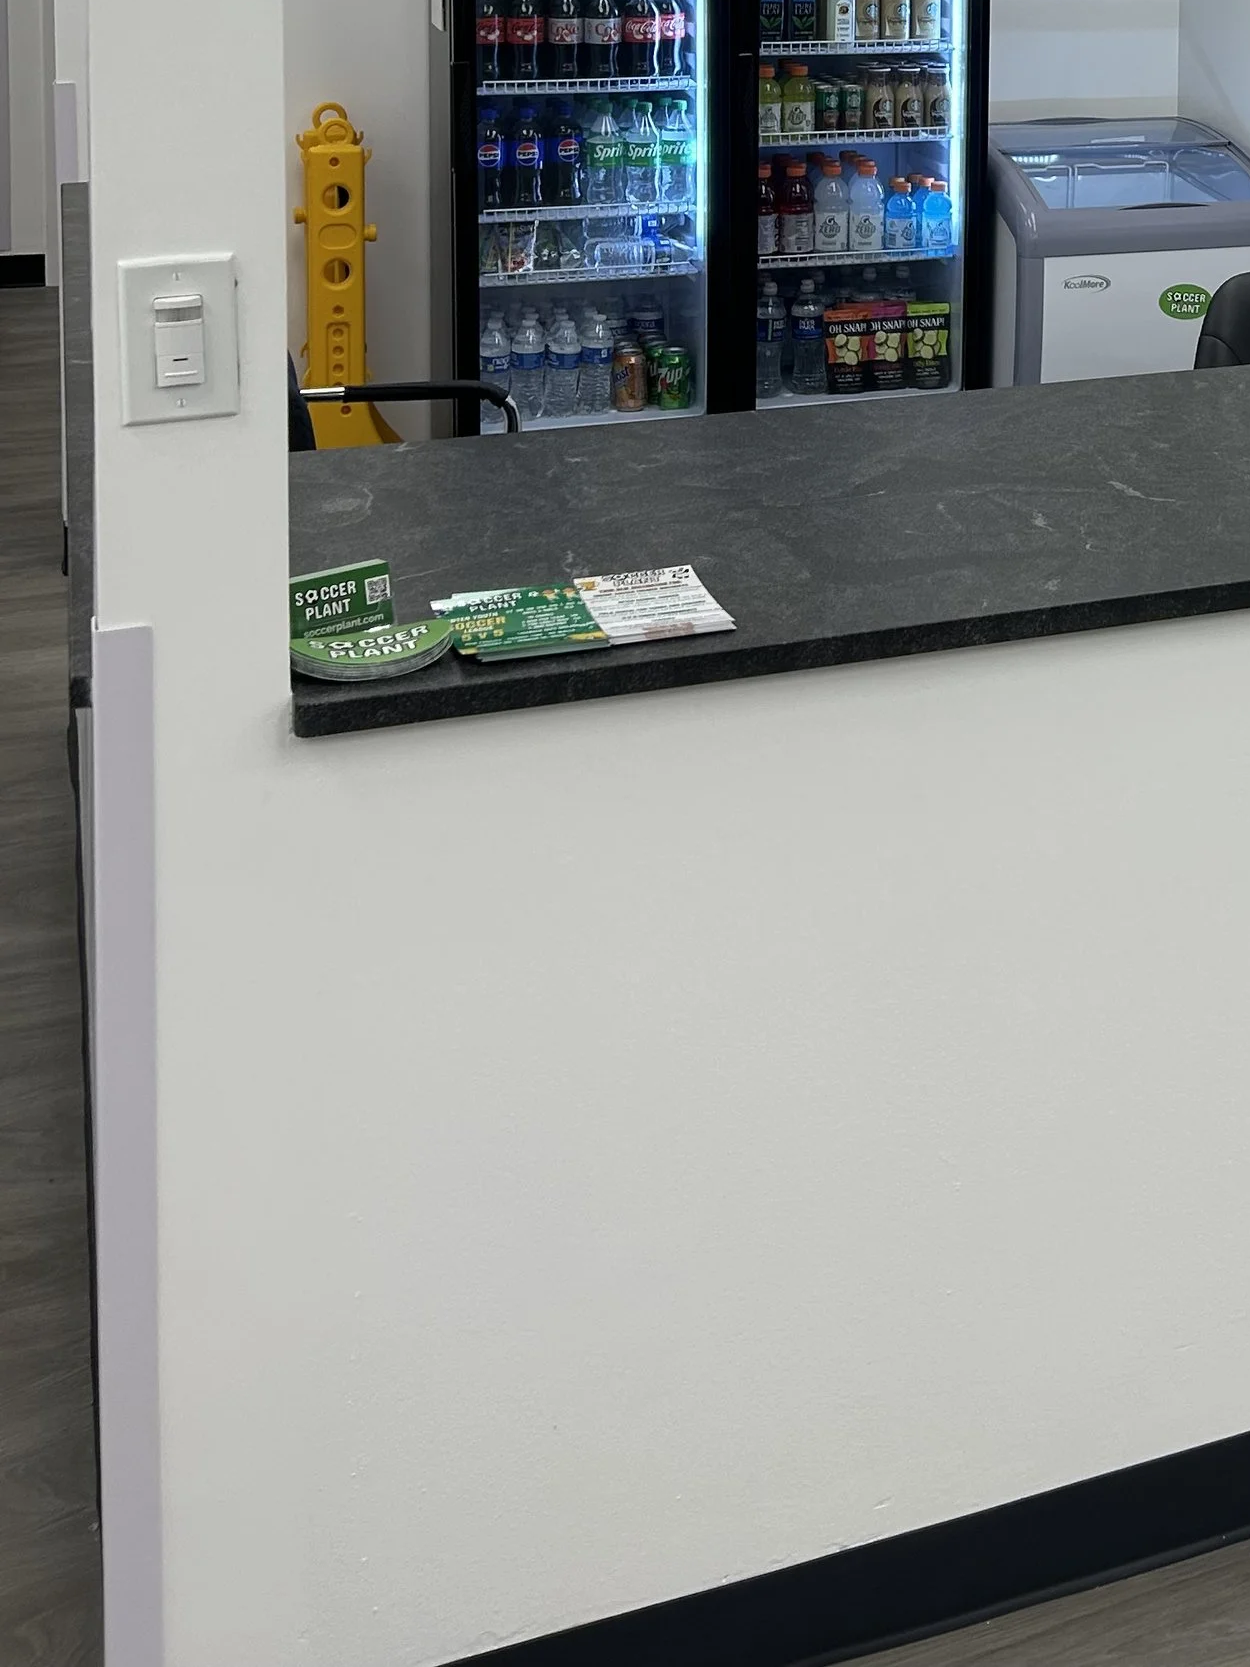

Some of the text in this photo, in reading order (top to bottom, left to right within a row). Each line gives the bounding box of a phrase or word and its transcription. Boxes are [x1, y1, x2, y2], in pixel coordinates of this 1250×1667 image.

[1166, 290, 1206, 304] SOCCER
[1171, 303, 1200, 314] PLANT
[829, 325, 842, 334] OH
[295, 581, 357, 607] SOCCER
[305, 598, 351, 621] PLANT
[469, 600, 517, 613] PLANT
[309, 625, 429, 649] SOCCER
[329, 639, 417, 659] PLANT
